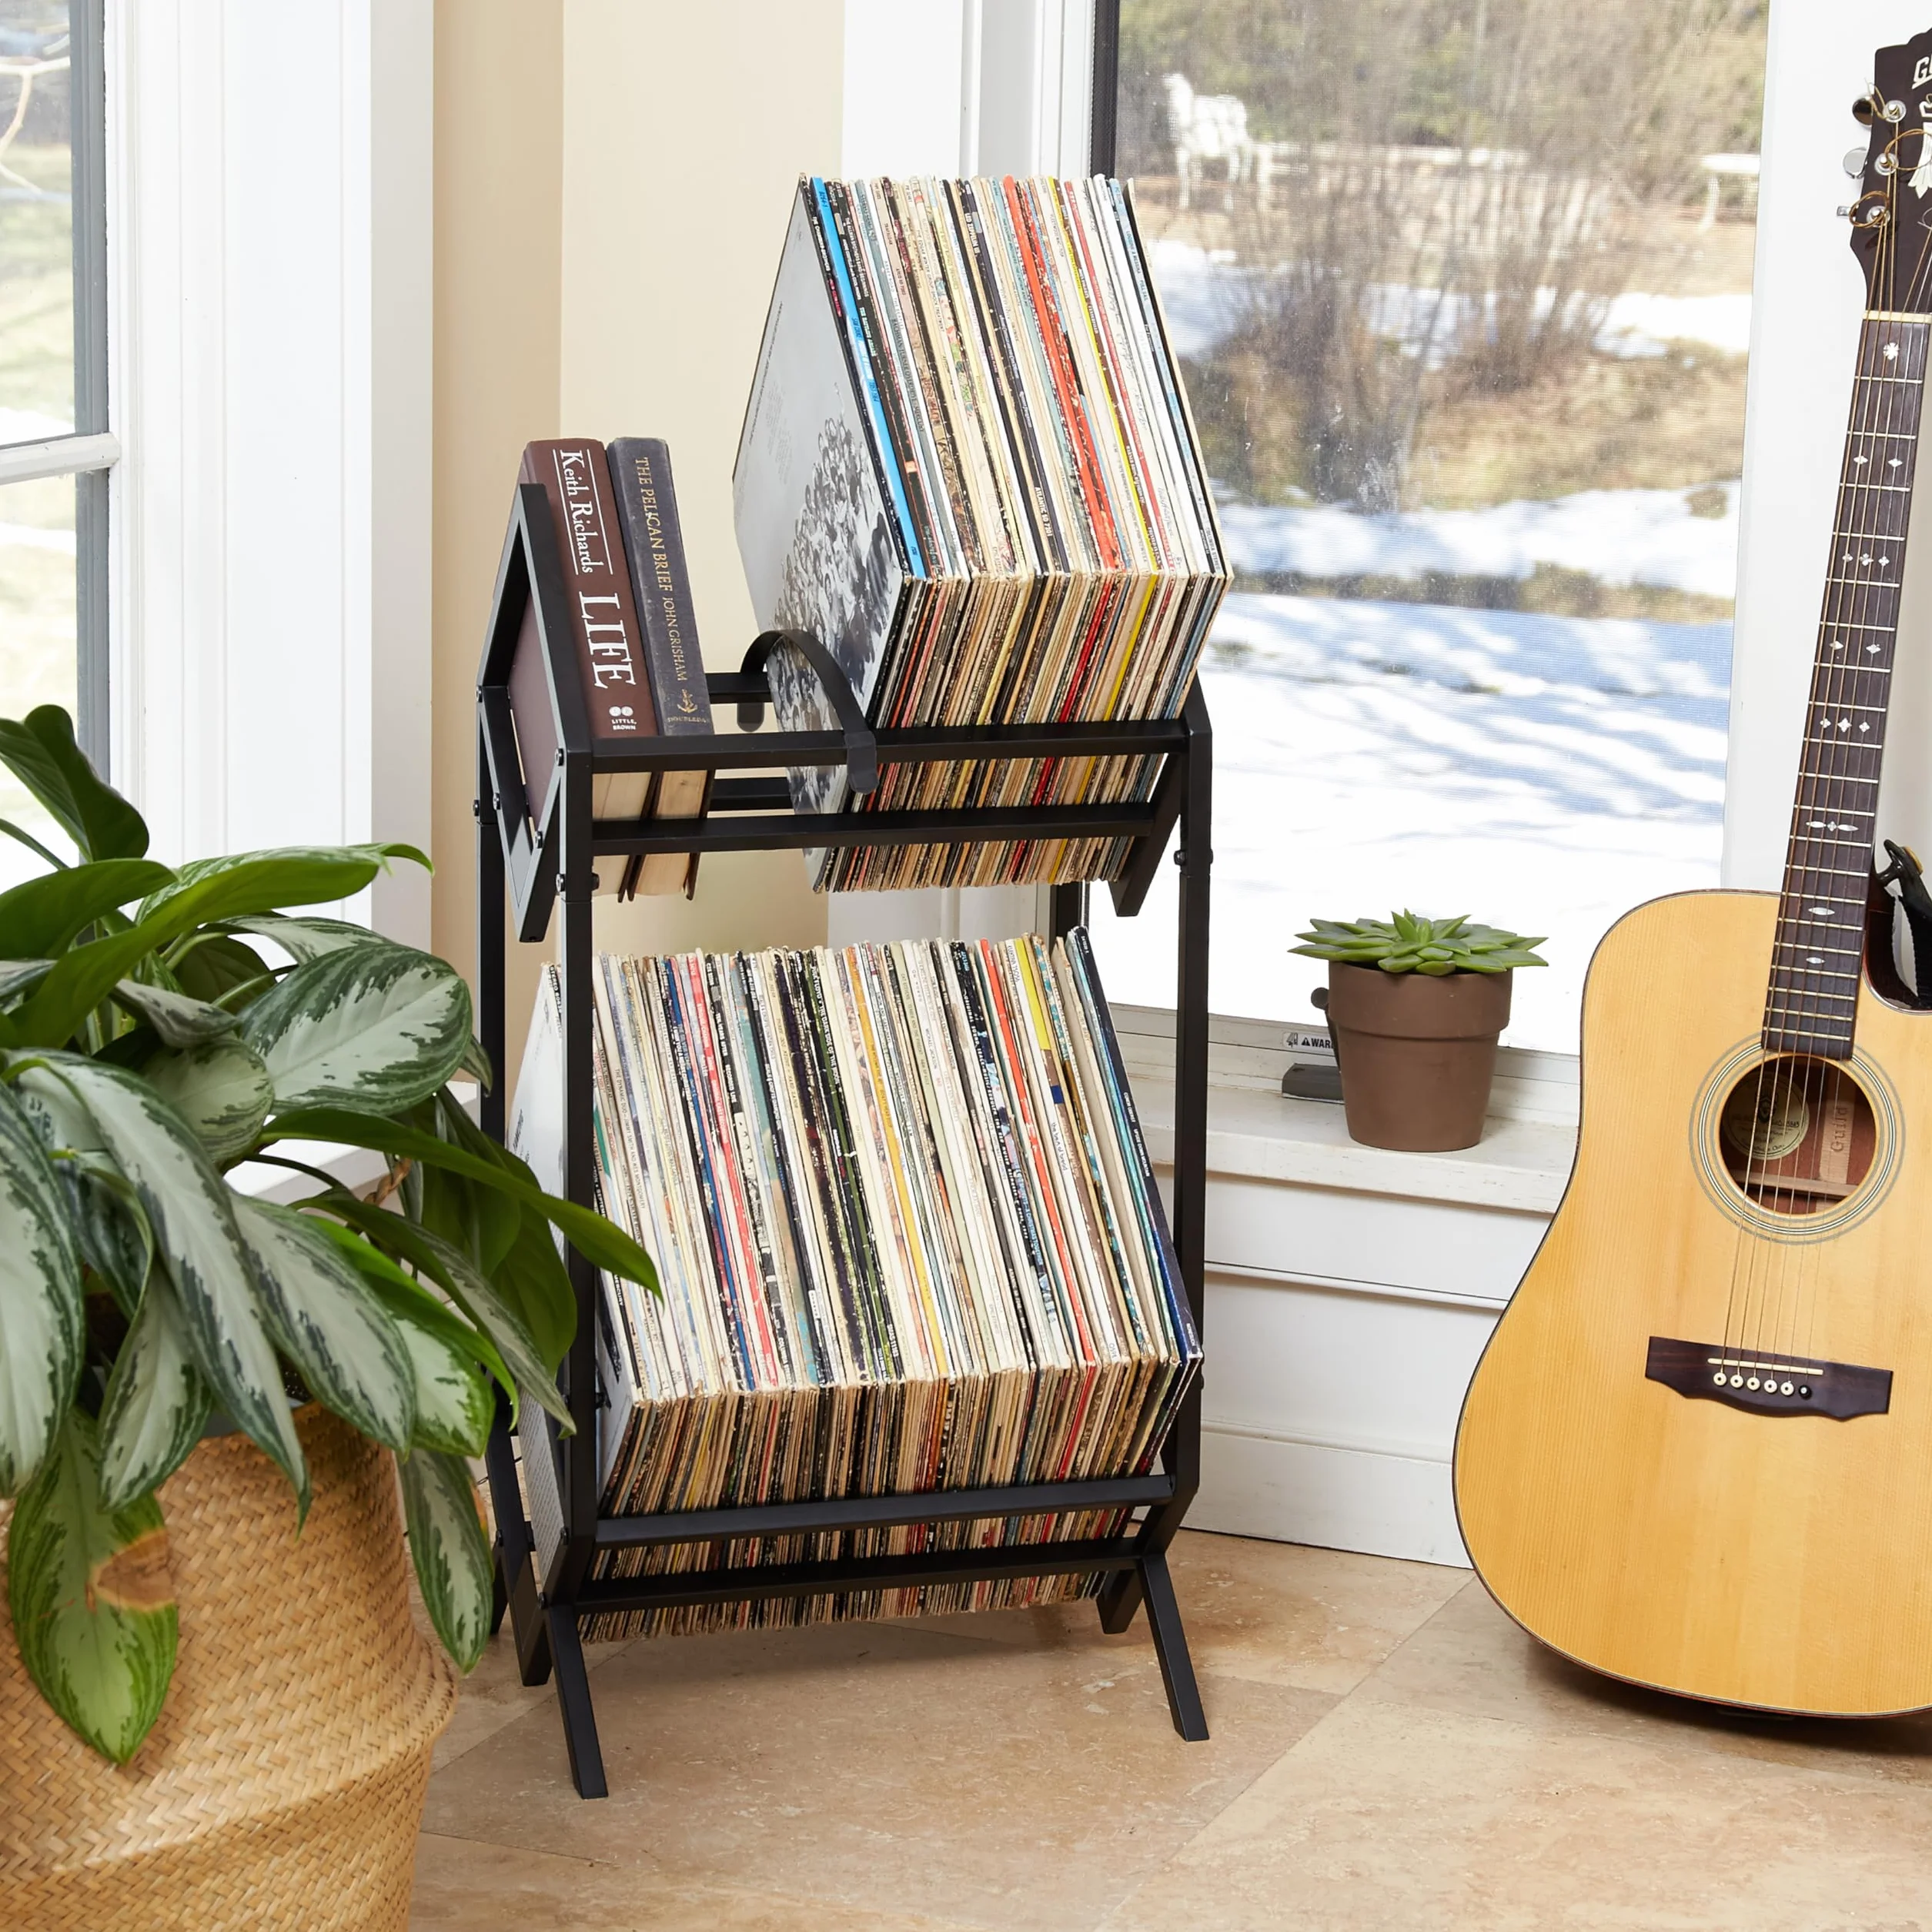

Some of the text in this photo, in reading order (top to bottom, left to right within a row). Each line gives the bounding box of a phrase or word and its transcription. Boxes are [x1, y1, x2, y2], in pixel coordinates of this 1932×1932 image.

[964, 212, 972, 222] LED
[967, 223, 978, 246] ZEPPELIN
[560, 449, 604, 573] Keith Richards
[1035, 486, 1046, 513] ATLANTIC
[635, 456, 673, 592] THE PELICAN BRIEF
[579, 590, 637, 689] LIFE
[662, 597, 688, 681] JOHN GRISHAM
[810, 965, 819, 979] PINK
[813, 979, 823, 999] FLOYD
[821, 1017, 830, 1033] DARK
[827, 1046, 834, 1055] OF
[924, 1028, 933, 1048] MICHAEL
[929, 1048, 938, 1068] JACKSON
[828, 1055, 837, 1066] THE
[831, 1067, 841, 1084] MOON
[617, 1079, 626, 1101] DYNAMIC
[634, 1174, 645, 1208] MONTGOMERY
[1058, 1153, 1068, 1170] bread
[613, 1274, 623, 1306] MERCURY
